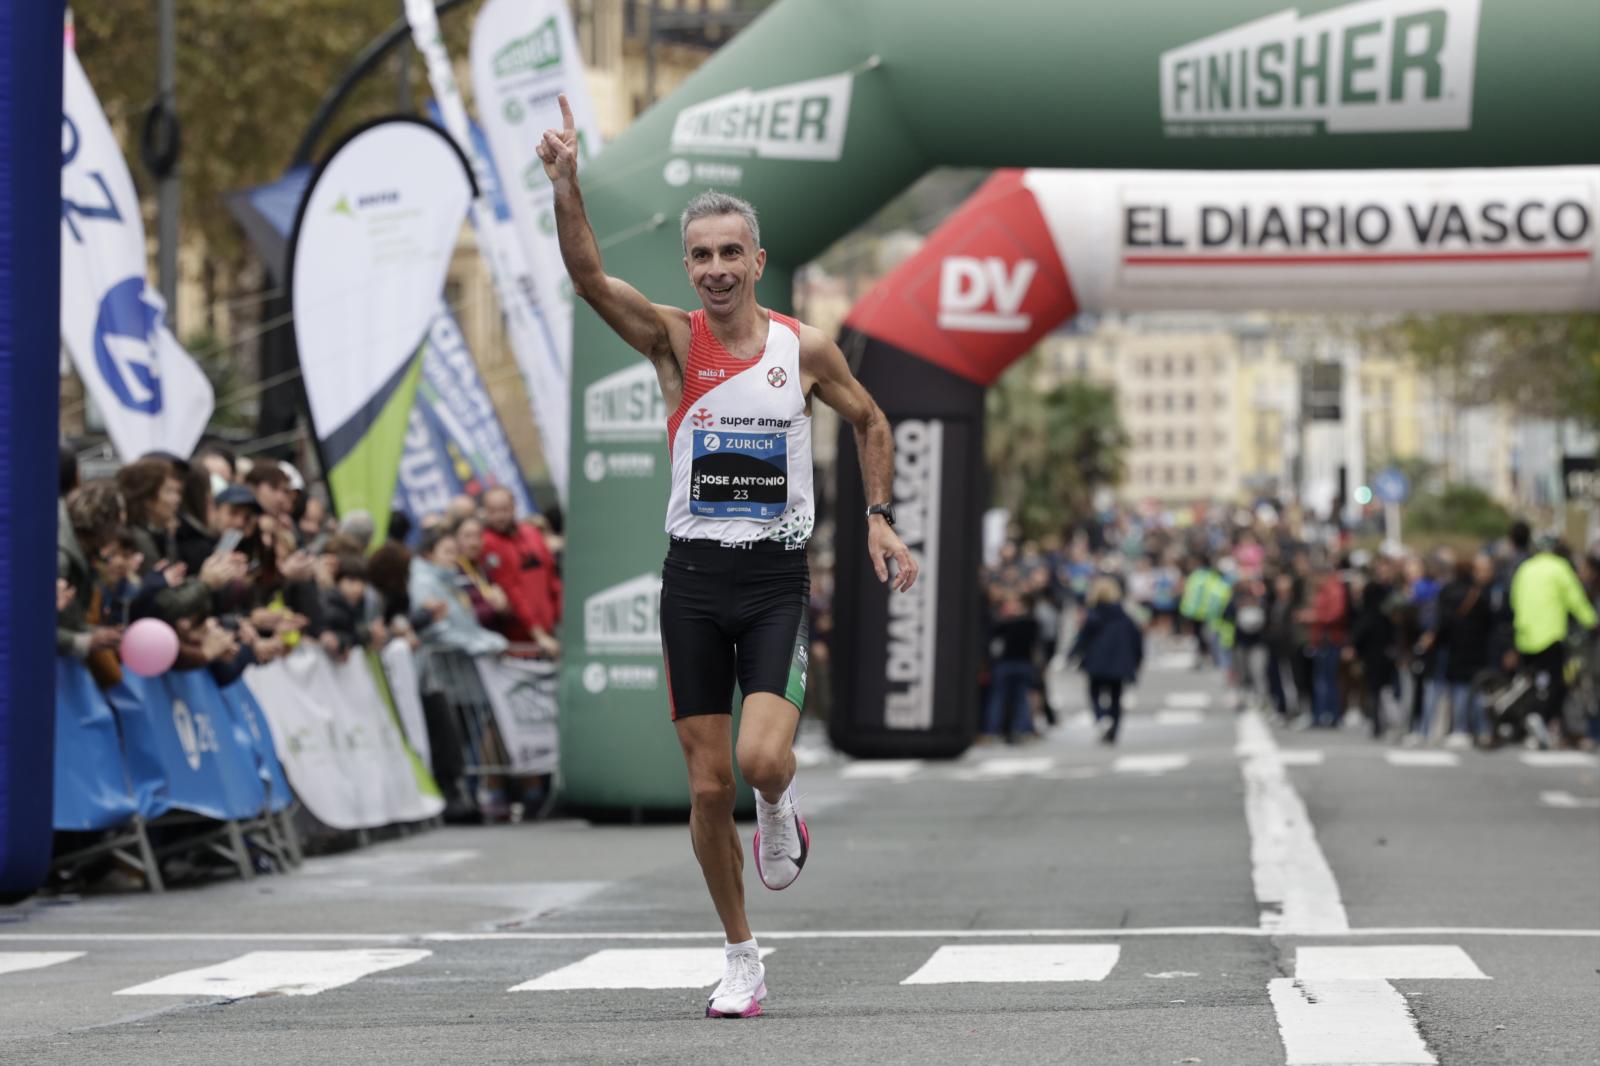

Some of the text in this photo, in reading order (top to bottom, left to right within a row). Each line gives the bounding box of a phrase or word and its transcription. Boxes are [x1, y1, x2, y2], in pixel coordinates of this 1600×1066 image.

[1174, 9, 1447, 113] FINISHER
[1125, 201, 1590, 247] EL DIARIO VASCO
[940, 257, 1037, 315] DV
[720, 416, 755, 427] super
[725, 438, 773, 449] ZURICH
[701, 475, 730, 485] JOSE
[732, 476, 785, 486] ANTONIO
[733, 489, 749, 500] 23
